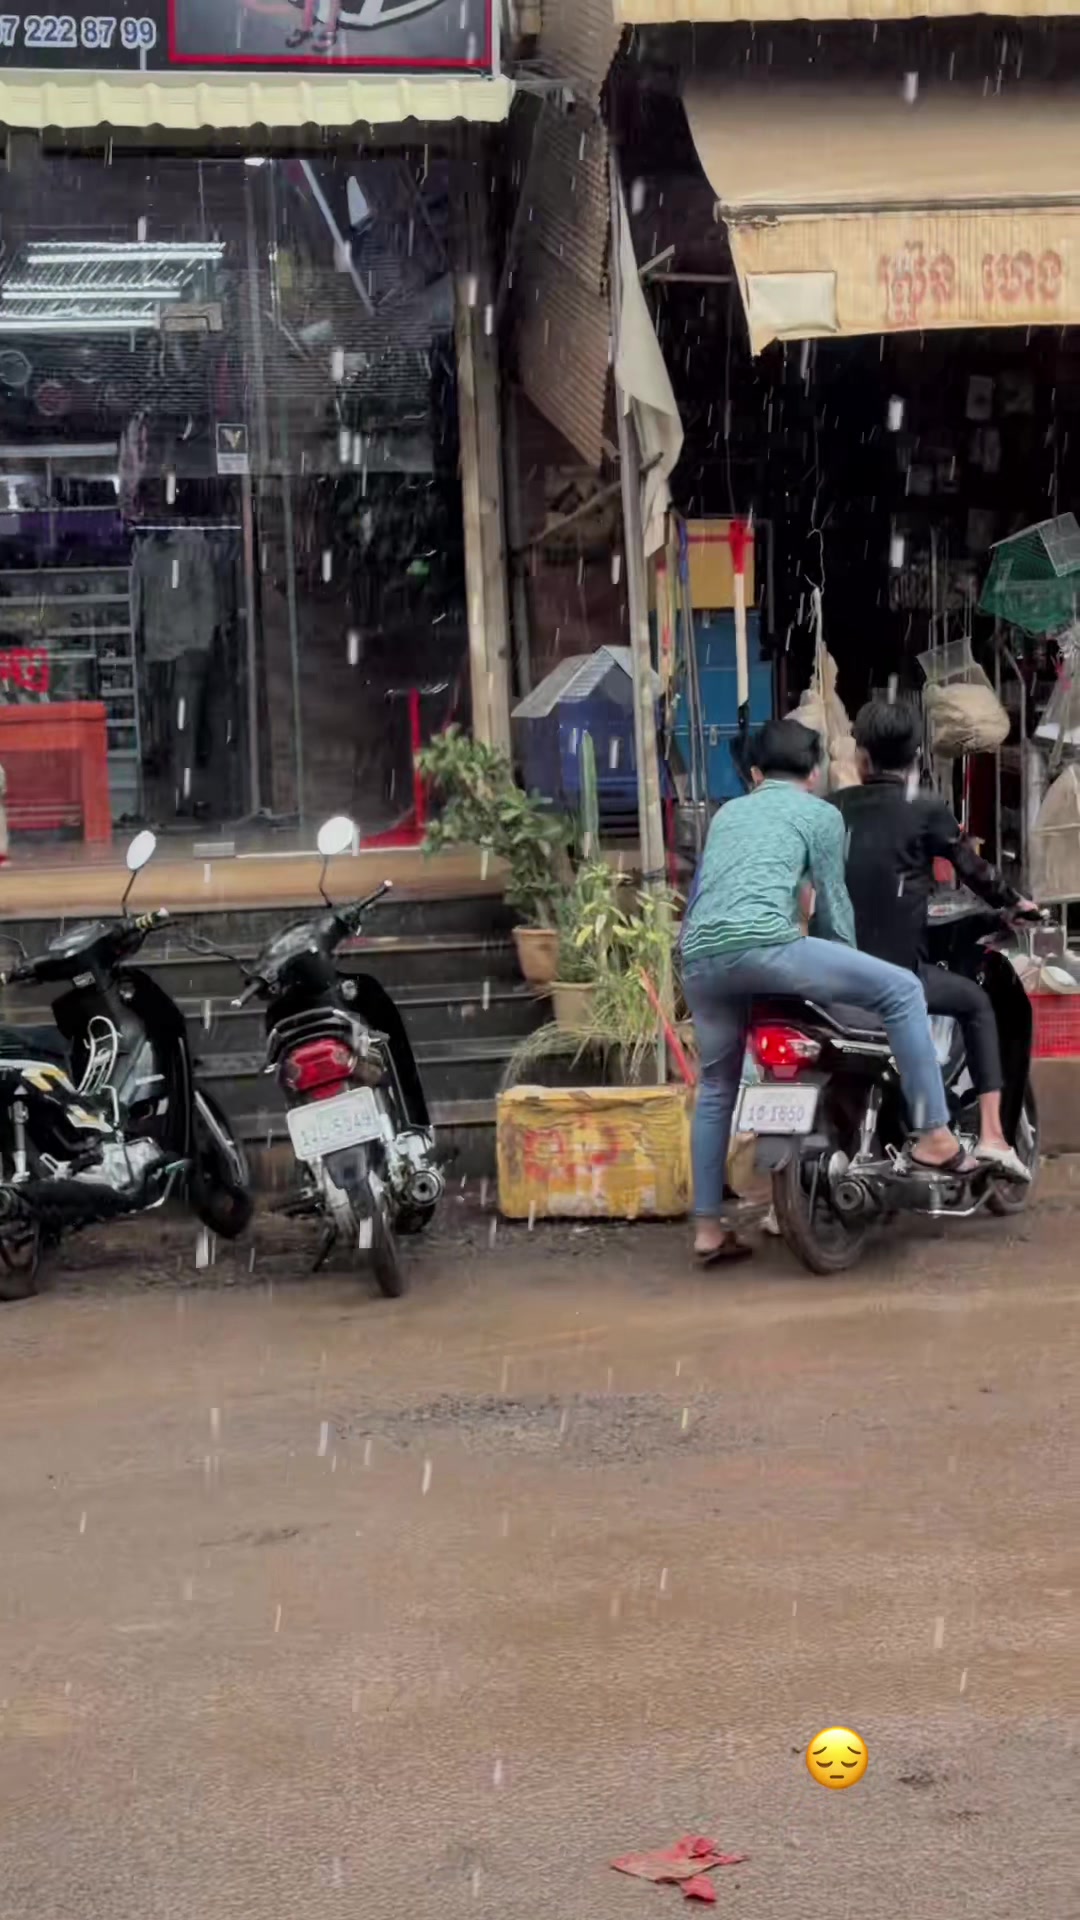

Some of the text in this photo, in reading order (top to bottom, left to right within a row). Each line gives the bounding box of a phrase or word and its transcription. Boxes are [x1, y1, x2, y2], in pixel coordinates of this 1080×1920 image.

[0, 16, 156, 48] 7 222 87 99
